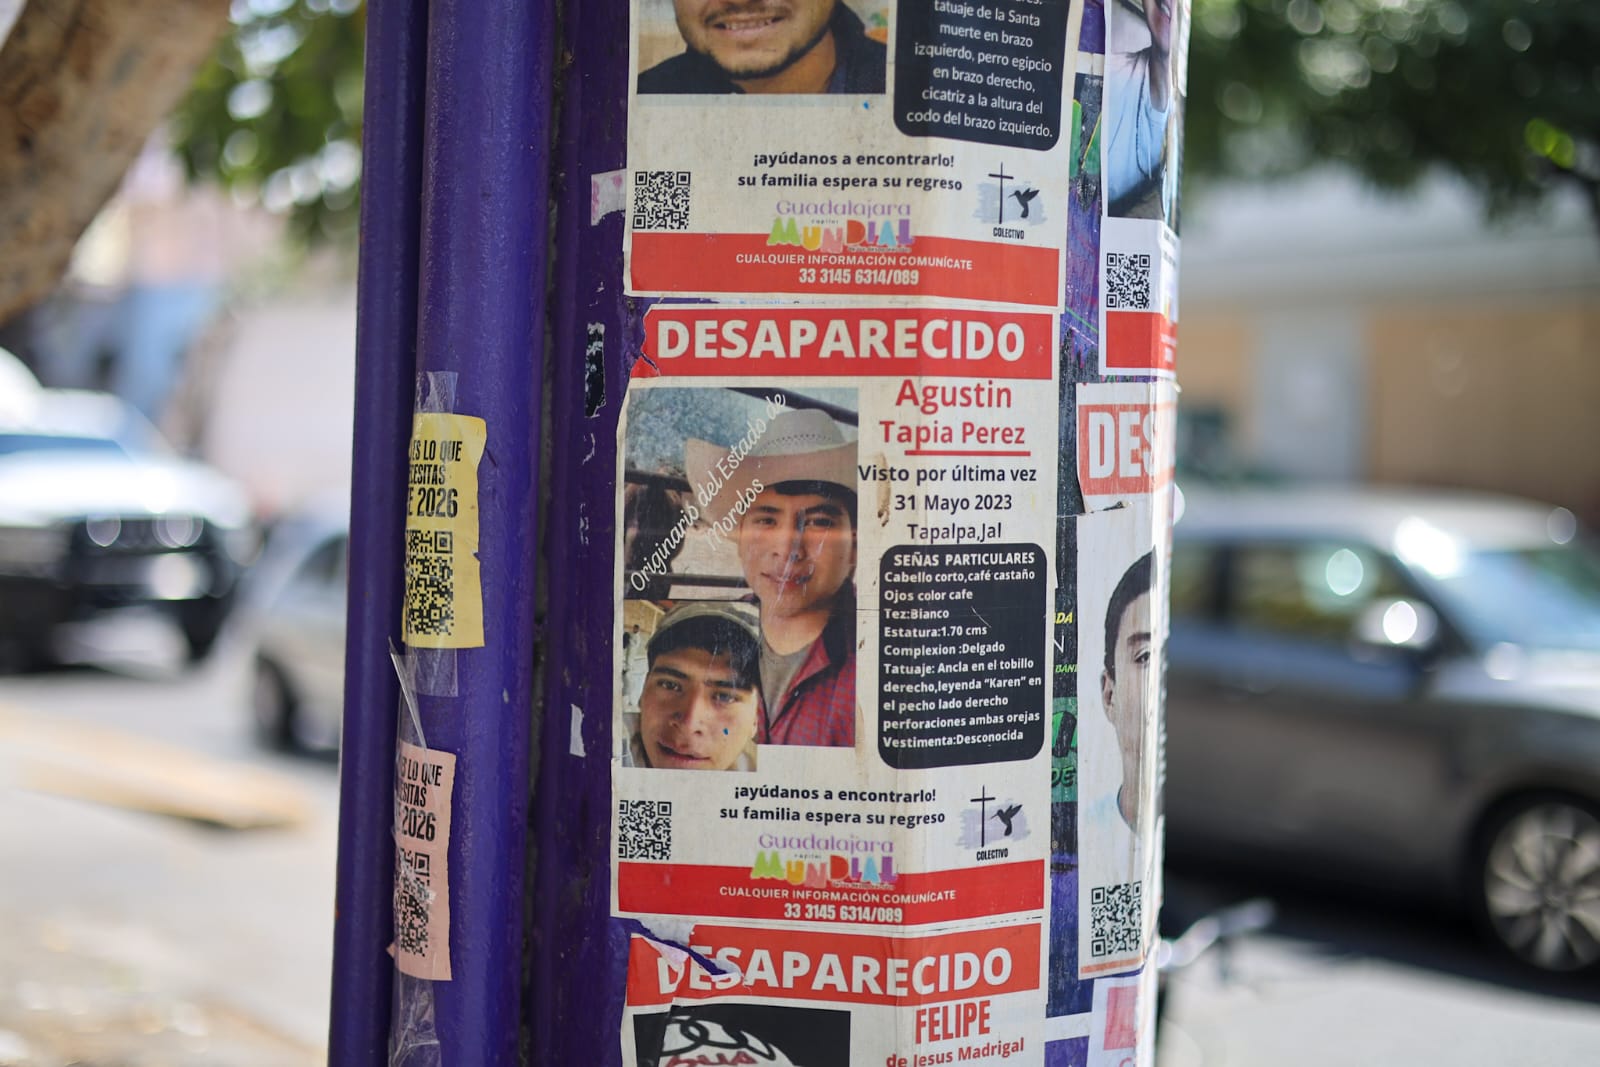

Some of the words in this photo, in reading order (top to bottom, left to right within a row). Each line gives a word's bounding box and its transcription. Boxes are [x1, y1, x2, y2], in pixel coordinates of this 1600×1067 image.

[934, 0, 974, 18] tatuaje
[977, 7, 992, 19] de
[995, 8, 1005, 21] la
[1008, 10, 1040, 26] Santa
[940, 23, 981, 39] muerte
[984, 29, 998, 42] en
[1001, 31, 1033, 47] brazo
[914, 42, 975, 62] izquierdo,
[977, 52, 1009, 66] perro
[1011, 57, 1052, 72] egipcio
[933, 68, 949, 79] en
[952, 67, 983, 84] brazo
[986, 73, 1036, 93] derecho,
[922, 86, 965, 104] cicatriz
[968, 94, 975, 105] a
[978, 93, 988, 107] la
[990, 96, 1023, 112] altura
[1026, 101, 1043, 114] del
[906, 109, 941, 123] codo
[943, 111, 961, 126] del
[964, 114, 996, 130] brazo
[999, 118, 1053, 138] izquierdo.
[753, 152, 838, 168] ¡ayúdanos
[842, 155, 851, 165] a
[855, 153, 955, 167] encontrarlo!
[738, 175, 756, 187] su
[761, 173, 818, 188] familia
[822, 176, 878, 190] espera
[882, 177, 901, 189] su
[906, 177, 963, 191] regreso
[776, 199, 911, 219] Guadalajara
[766, 216, 915, 254] MUNDIAL
[993, 227, 1025, 240] COLECTIVO
[736, 253, 804, 265] CUALQUIER
[807, 253, 896, 267] INFORMACIÓN
[899, 255, 973, 271] COMUNÍCATE
[799, 268, 816, 283] 33
[820, 268, 851, 284] 3145
[855, 268, 919, 285] 6314/089
[656, 317, 1026, 363] DESAPARECIDO
[894, 378, 1013, 416] Agustin
[879, 418, 954, 450] Tapia
[960, 420, 1026, 445] Perez
[423, 440, 436, 461] LO
[440, 440, 463, 463] QUE
[858, 464, 910, 482] Visto
[916, 468, 947, 486] por
[952, 464, 1005, 482] última
[1010, 468, 1037, 482] vez
[417, 487, 458, 518] 2026
[630, 505, 699, 591] Originario
[697, 470, 723, 507] del
[716, 418, 767, 481] Estado
[765, 393, 786, 420] de
[703, 477, 765, 550] Morelos
[895, 495, 916, 510] 31
[924, 495, 970, 515] Mayo
[974, 494, 1012, 510] 2023
[907, 522, 1002, 545] Tapalpa,Jal
[894, 551, 940, 567] SEÑAS
[945, 552, 1035, 566] PARTICULARES
[884, 571, 932, 583] Cabello
[993, 569, 1035, 581] castaño
[884, 590, 914, 604] Ojos
[917, 590, 946, 601] color
[949, 589, 973, 600] cafe
[884, 626, 963, 638] Estatura:1.70
[965, 626, 988, 636] cms
[884, 644, 956, 660] Complexion
[884, 663, 935, 677] Tatuaje:
[937, 661, 969, 674] Ancla
[971, 662, 985, 671] en
[987, 659, 997, 671] el
[1000, 658, 1034, 670] tobillo
[883, 679, 982, 694] derecho,leyenda
[1029, 677, 1042, 686] en
[883, 701, 895, 711] el
[898, 699, 936, 714] pecho
[938, 697, 962, 710] lado
[965, 695, 1009, 708] derecho
[883, 717, 966, 732] perforaciones
[969, 713, 1004, 726] ambas
[1006, 711, 1040, 725] orejas
[883, 729, 1024, 748] Vestimenta:Desconocida
[407, 759, 419, 781] LO
[422, 762, 443, 787] QUE
[735, 785, 819, 801] ¡ayúdanos
[824, 789, 833, 800] a
[838, 788, 936, 803] encontrarlo!
[402, 805, 436, 841] 2026
[720, 807, 738, 819] su
[743, 806, 801, 821] familia
[805, 811, 861, 826] espera
[866, 813, 885, 825] su
[889, 812, 945, 829] regreso
[758, 833, 894, 855] Guadalajara
[976, 848, 1009, 861] COLECTIVO
[750, 850, 898, 889] MUNDIAL
[719, 886, 789, 899] CUALQUIER
[792, 890, 880, 903] INFORMACIÓN
[883, 890, 956, 904] COMUNÍCATE
[784, 903, 801, 918] 33
[805, 904, 836, 920] 3145
[839, 905, 903, 923] 6314/089
[656, 944, 1012, 996] DESAPARECIDO
[915, 999, 991, 1045] FELIPE
[886, 1053, 908, 1067] de
[913, 1051, 953, 1067] Jesus
[958, 1037, 1024, 1061] Madrigal
